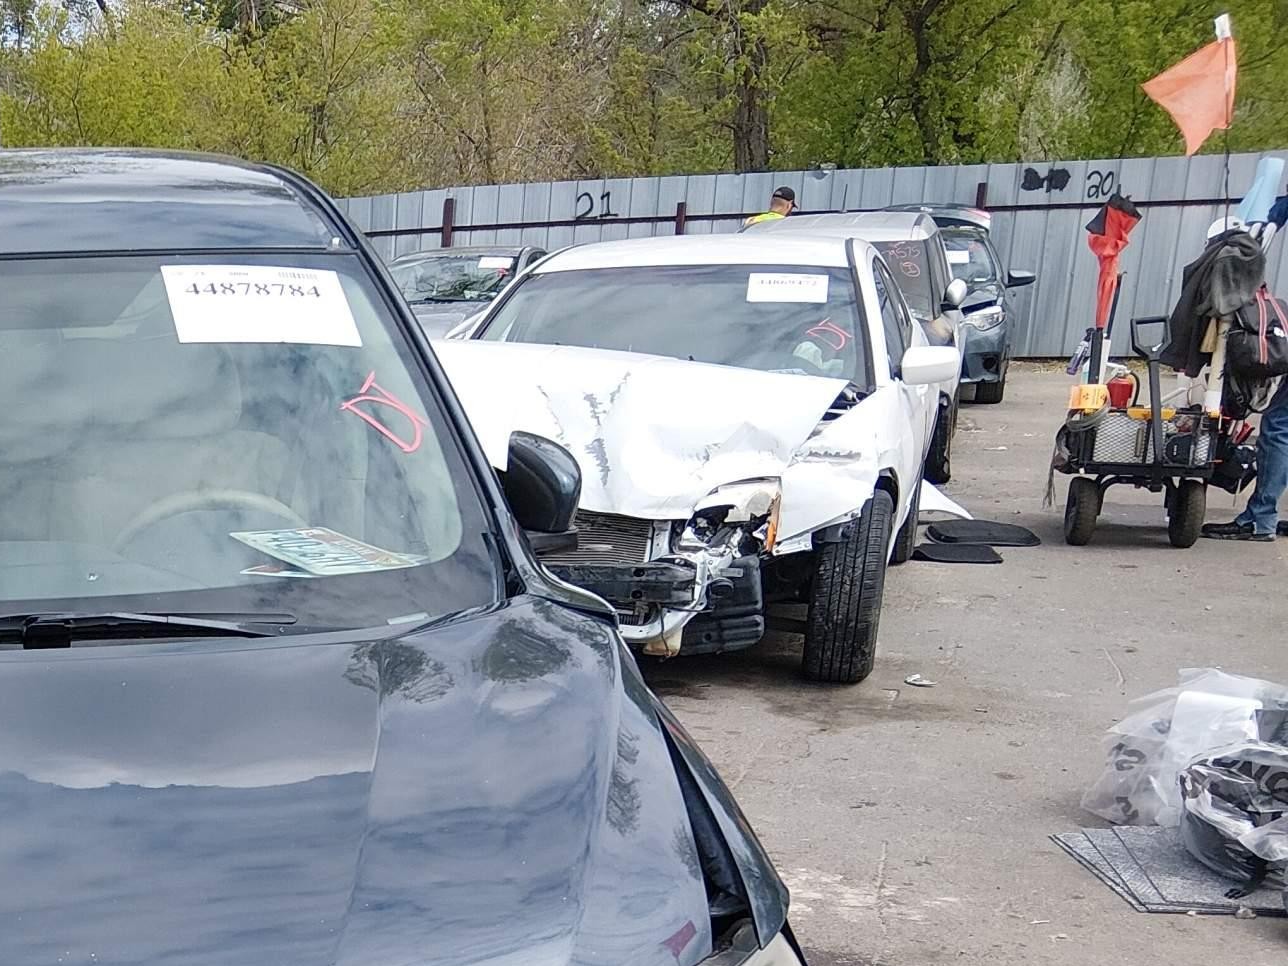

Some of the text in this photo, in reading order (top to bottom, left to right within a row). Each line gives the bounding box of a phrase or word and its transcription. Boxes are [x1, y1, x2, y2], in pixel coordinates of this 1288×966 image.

[1086, 170, 1114, 199] 20
[575, 191, 619, 219] 21
[185, 282, 320, 298] 44878784
